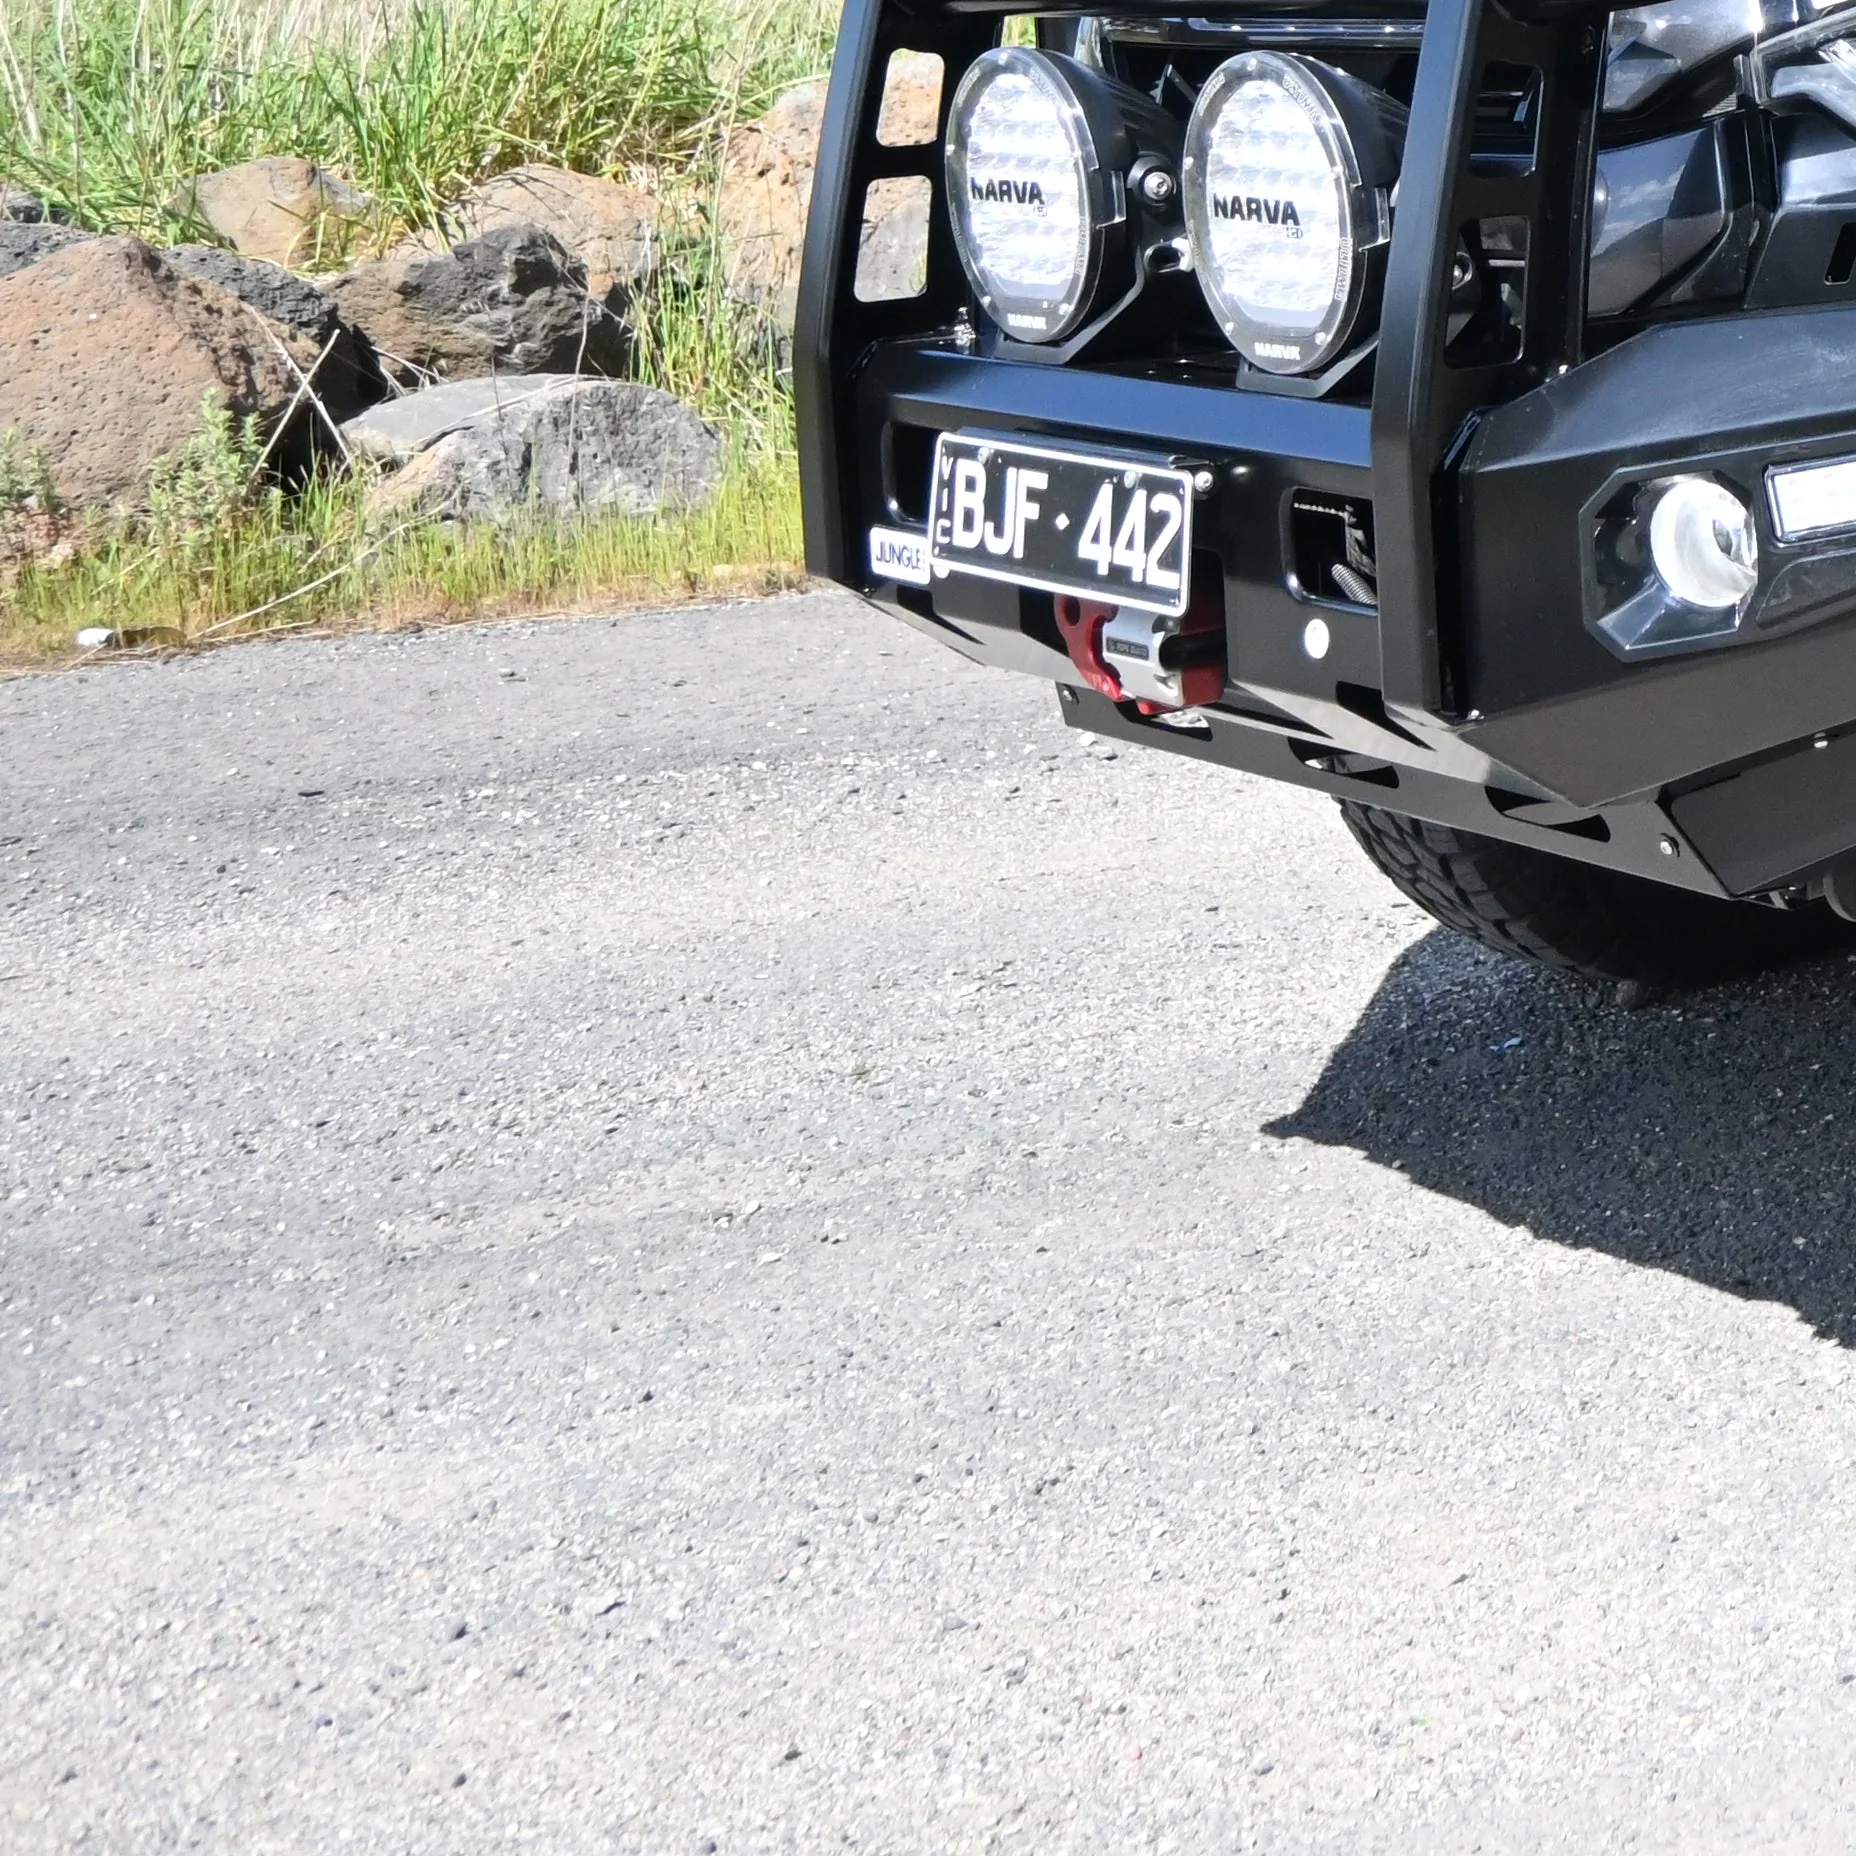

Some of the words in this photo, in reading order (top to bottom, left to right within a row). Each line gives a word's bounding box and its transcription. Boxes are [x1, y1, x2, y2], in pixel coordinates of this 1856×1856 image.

[970, 177, 1045, 205] NARVA
[1212, 193, 1301, 226] NARVA
[936, 455, 954, 544] VIC
[951, 458, 1049, 559] BJF
[1077, 483, 1182, 590] 442
[876, 541, 921, 570] JUNGLE
